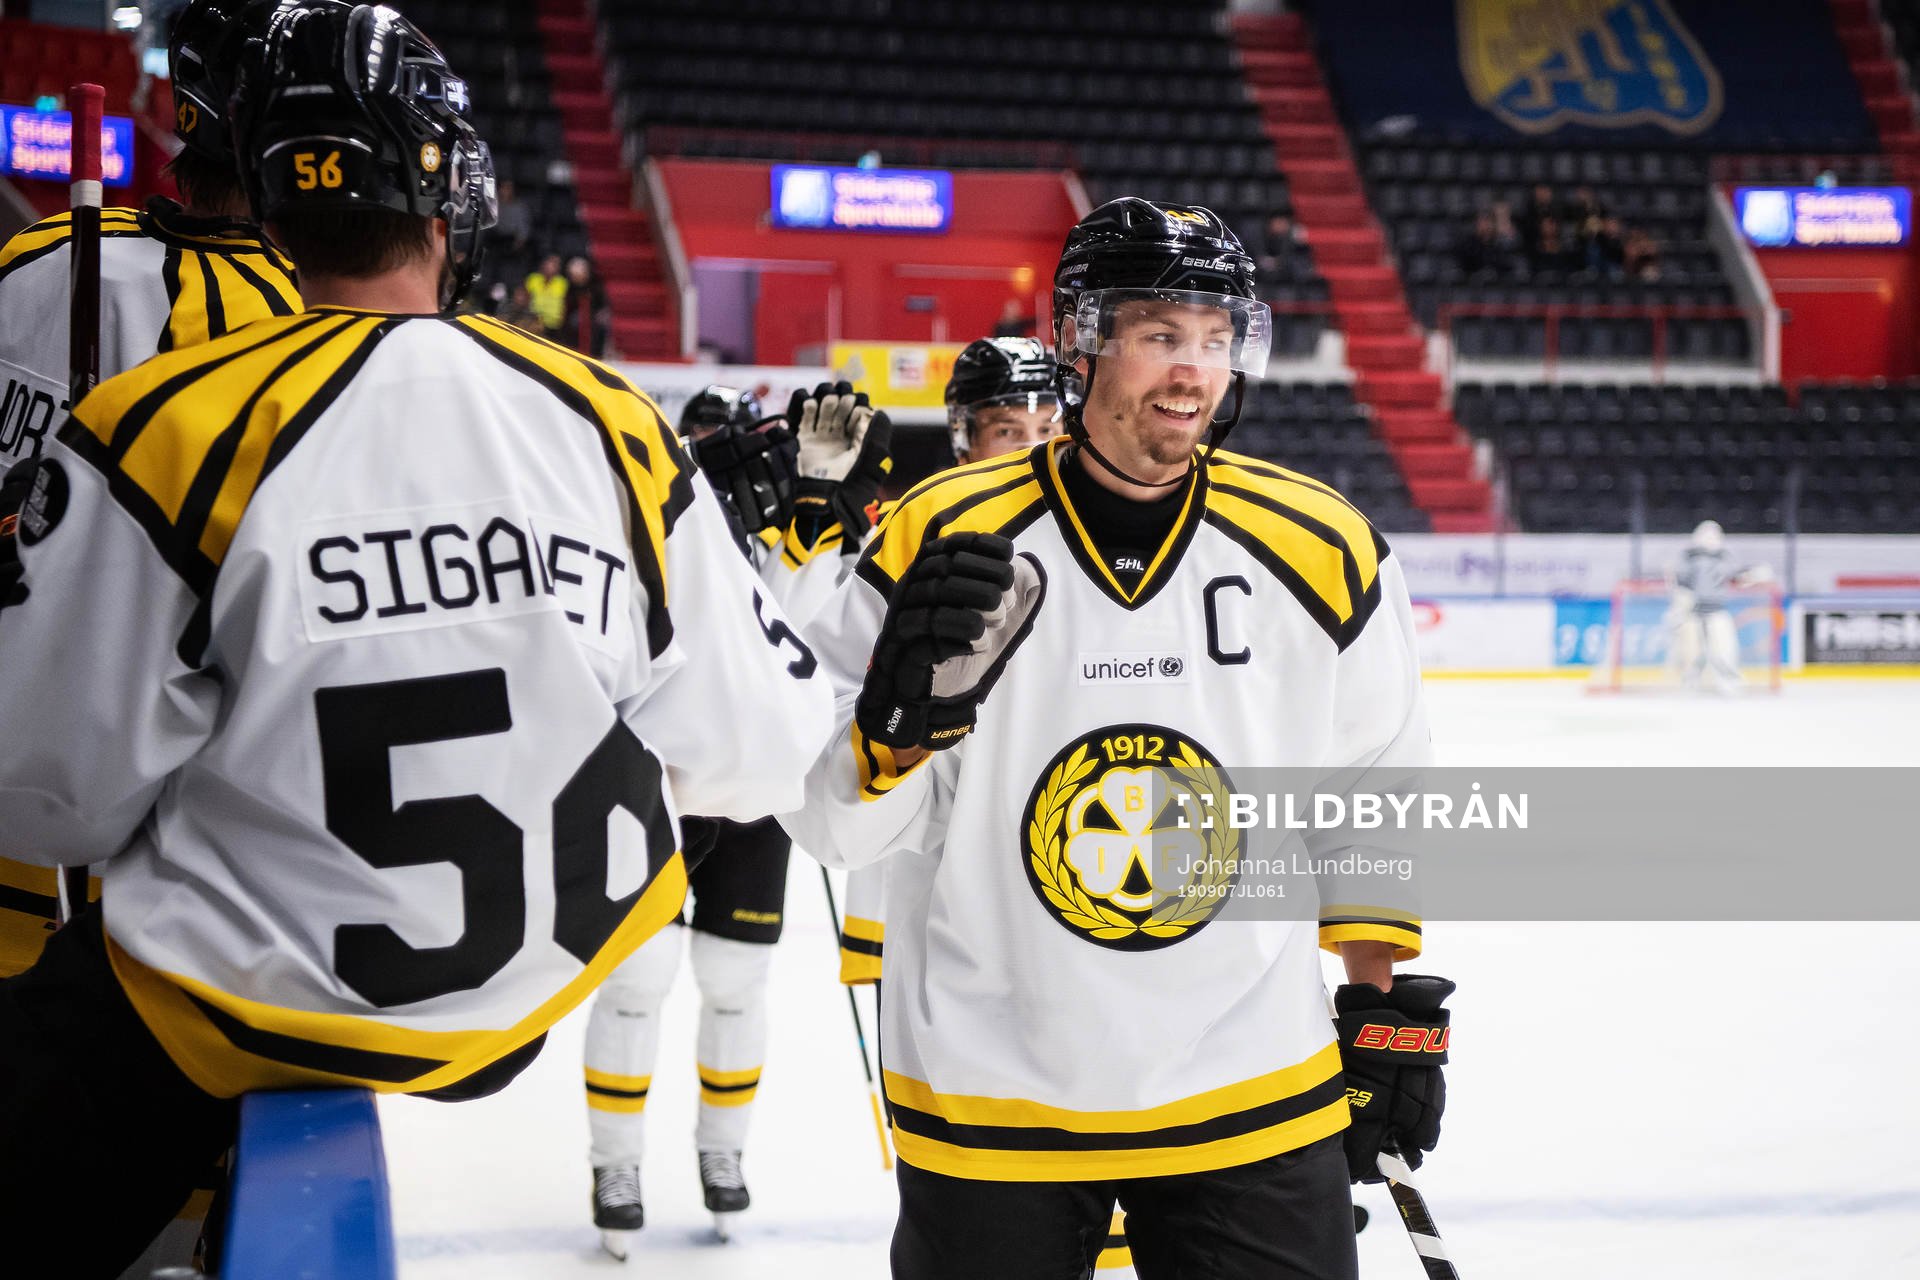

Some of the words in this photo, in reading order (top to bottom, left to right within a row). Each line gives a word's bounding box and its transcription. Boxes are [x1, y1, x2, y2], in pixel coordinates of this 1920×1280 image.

[294, 151, 343, 190] 56
[1115, 558, 1145, 571] SHL
[1203, 575, 1252, 666] C
[1083, 657, 1155, 679] unicef
[886, 706, 903, 735] RÖDIN
[1101, 735, 1164, 762] 1912
[1125, 784, 1145, 813] B
